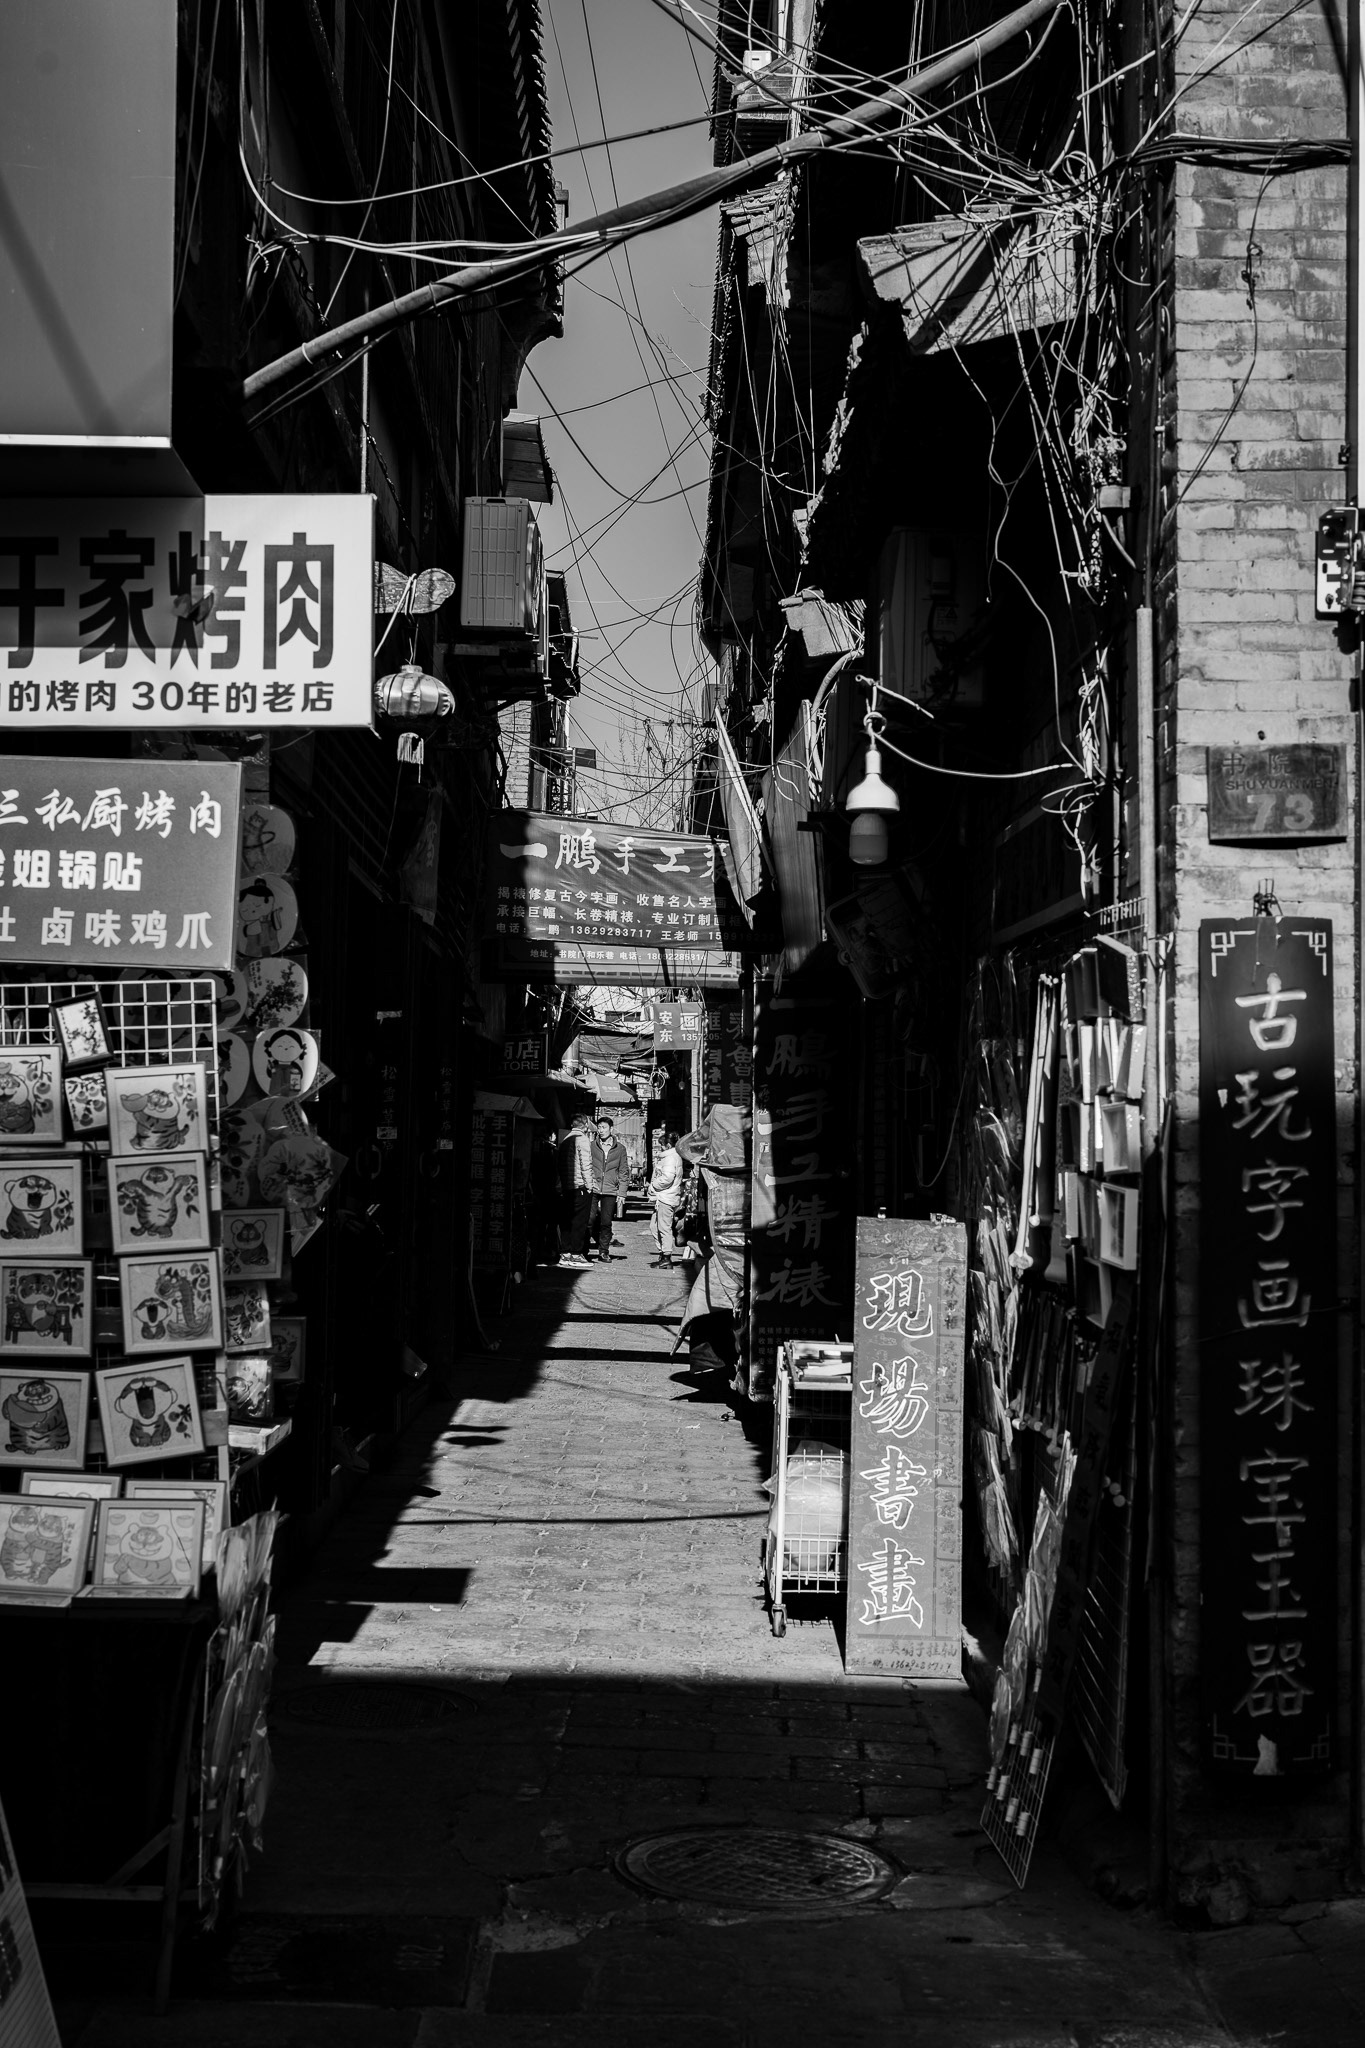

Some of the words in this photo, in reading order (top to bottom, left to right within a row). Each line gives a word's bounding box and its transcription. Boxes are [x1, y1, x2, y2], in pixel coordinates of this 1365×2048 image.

[0, 682, 117, 713] 的烤肉
[132, 680, 334, 713] 30年的老店
[1222, 752, 1338, 776] 书院门
[1247, 793, 1316, 831] 73
[40, 905, 214, 950] 卤味鸡爪
[569, 925, 652, 939] 13629283717
[660, 930, 699, 942] 王老师
[502, 1060, 540, 1071] TORE
[1231, 973, 1316, 1717] 古玩字画珠宝玉器
